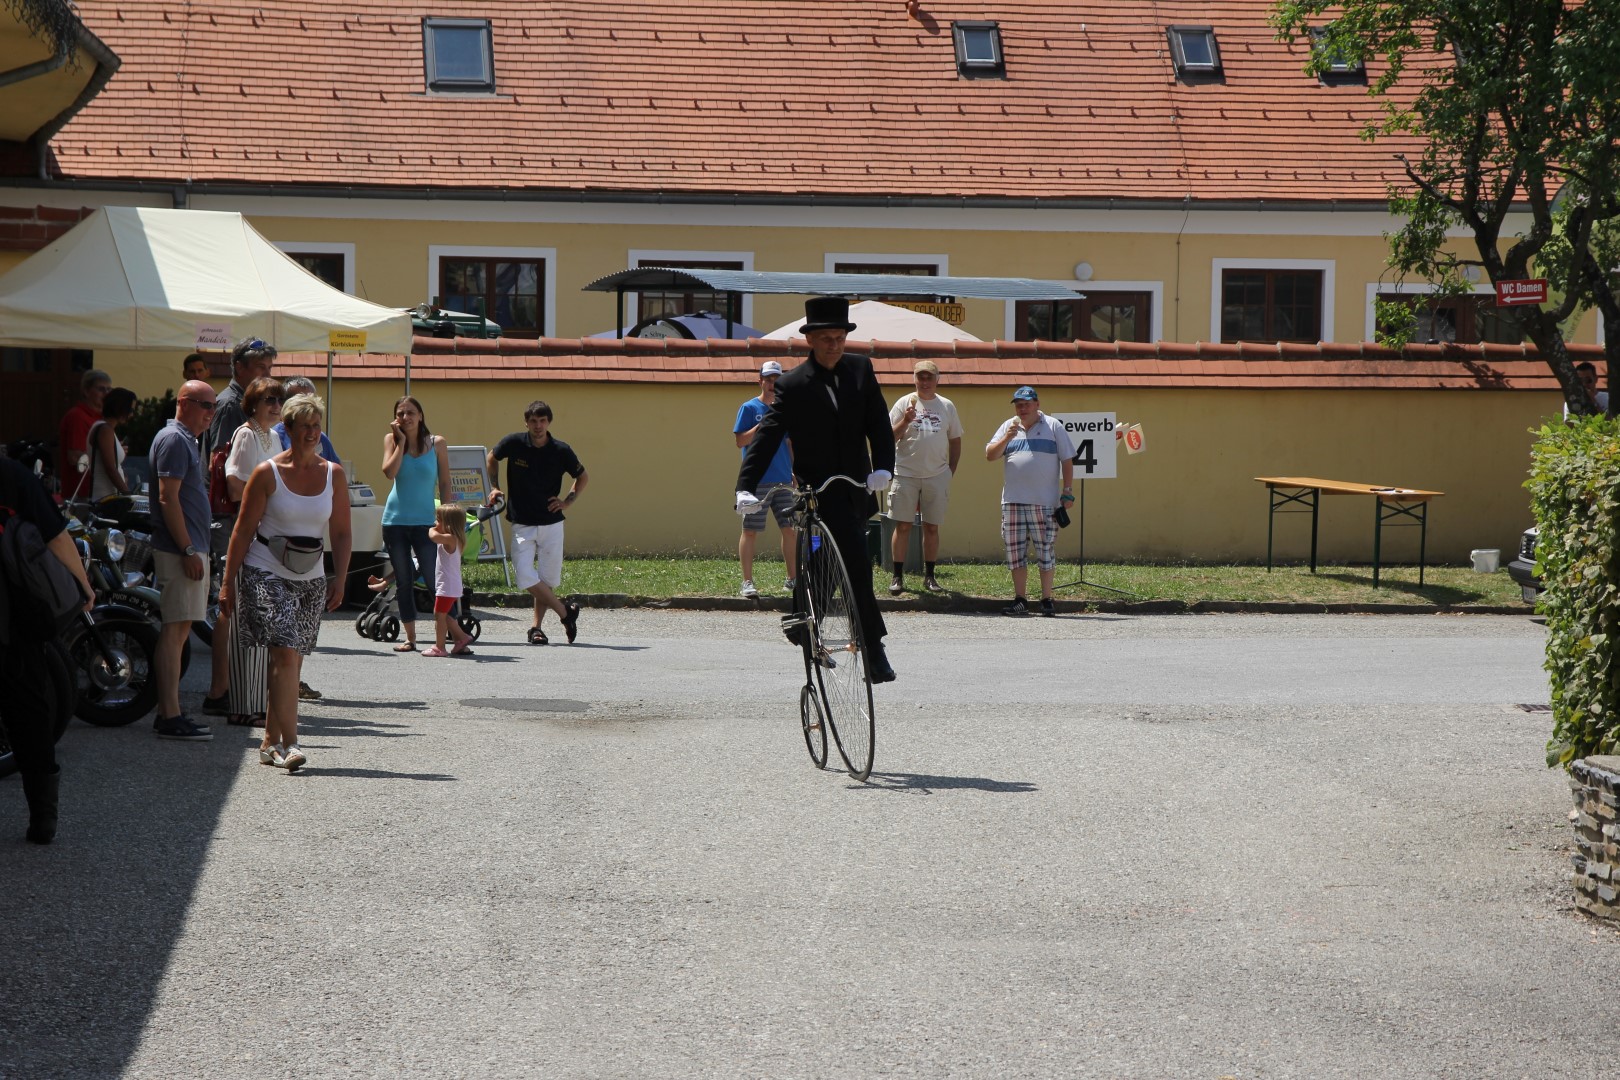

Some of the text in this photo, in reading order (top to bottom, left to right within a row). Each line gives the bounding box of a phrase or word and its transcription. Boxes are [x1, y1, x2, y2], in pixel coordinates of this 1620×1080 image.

[1501, 282, 1543, 294] WC Damen
[197, 335, 227, 343] Mandeln
[1058, 418, 1113, 432] ewerb
[1072, 439, 1097, 473] 4
[451, 475, 479, 486] timer
